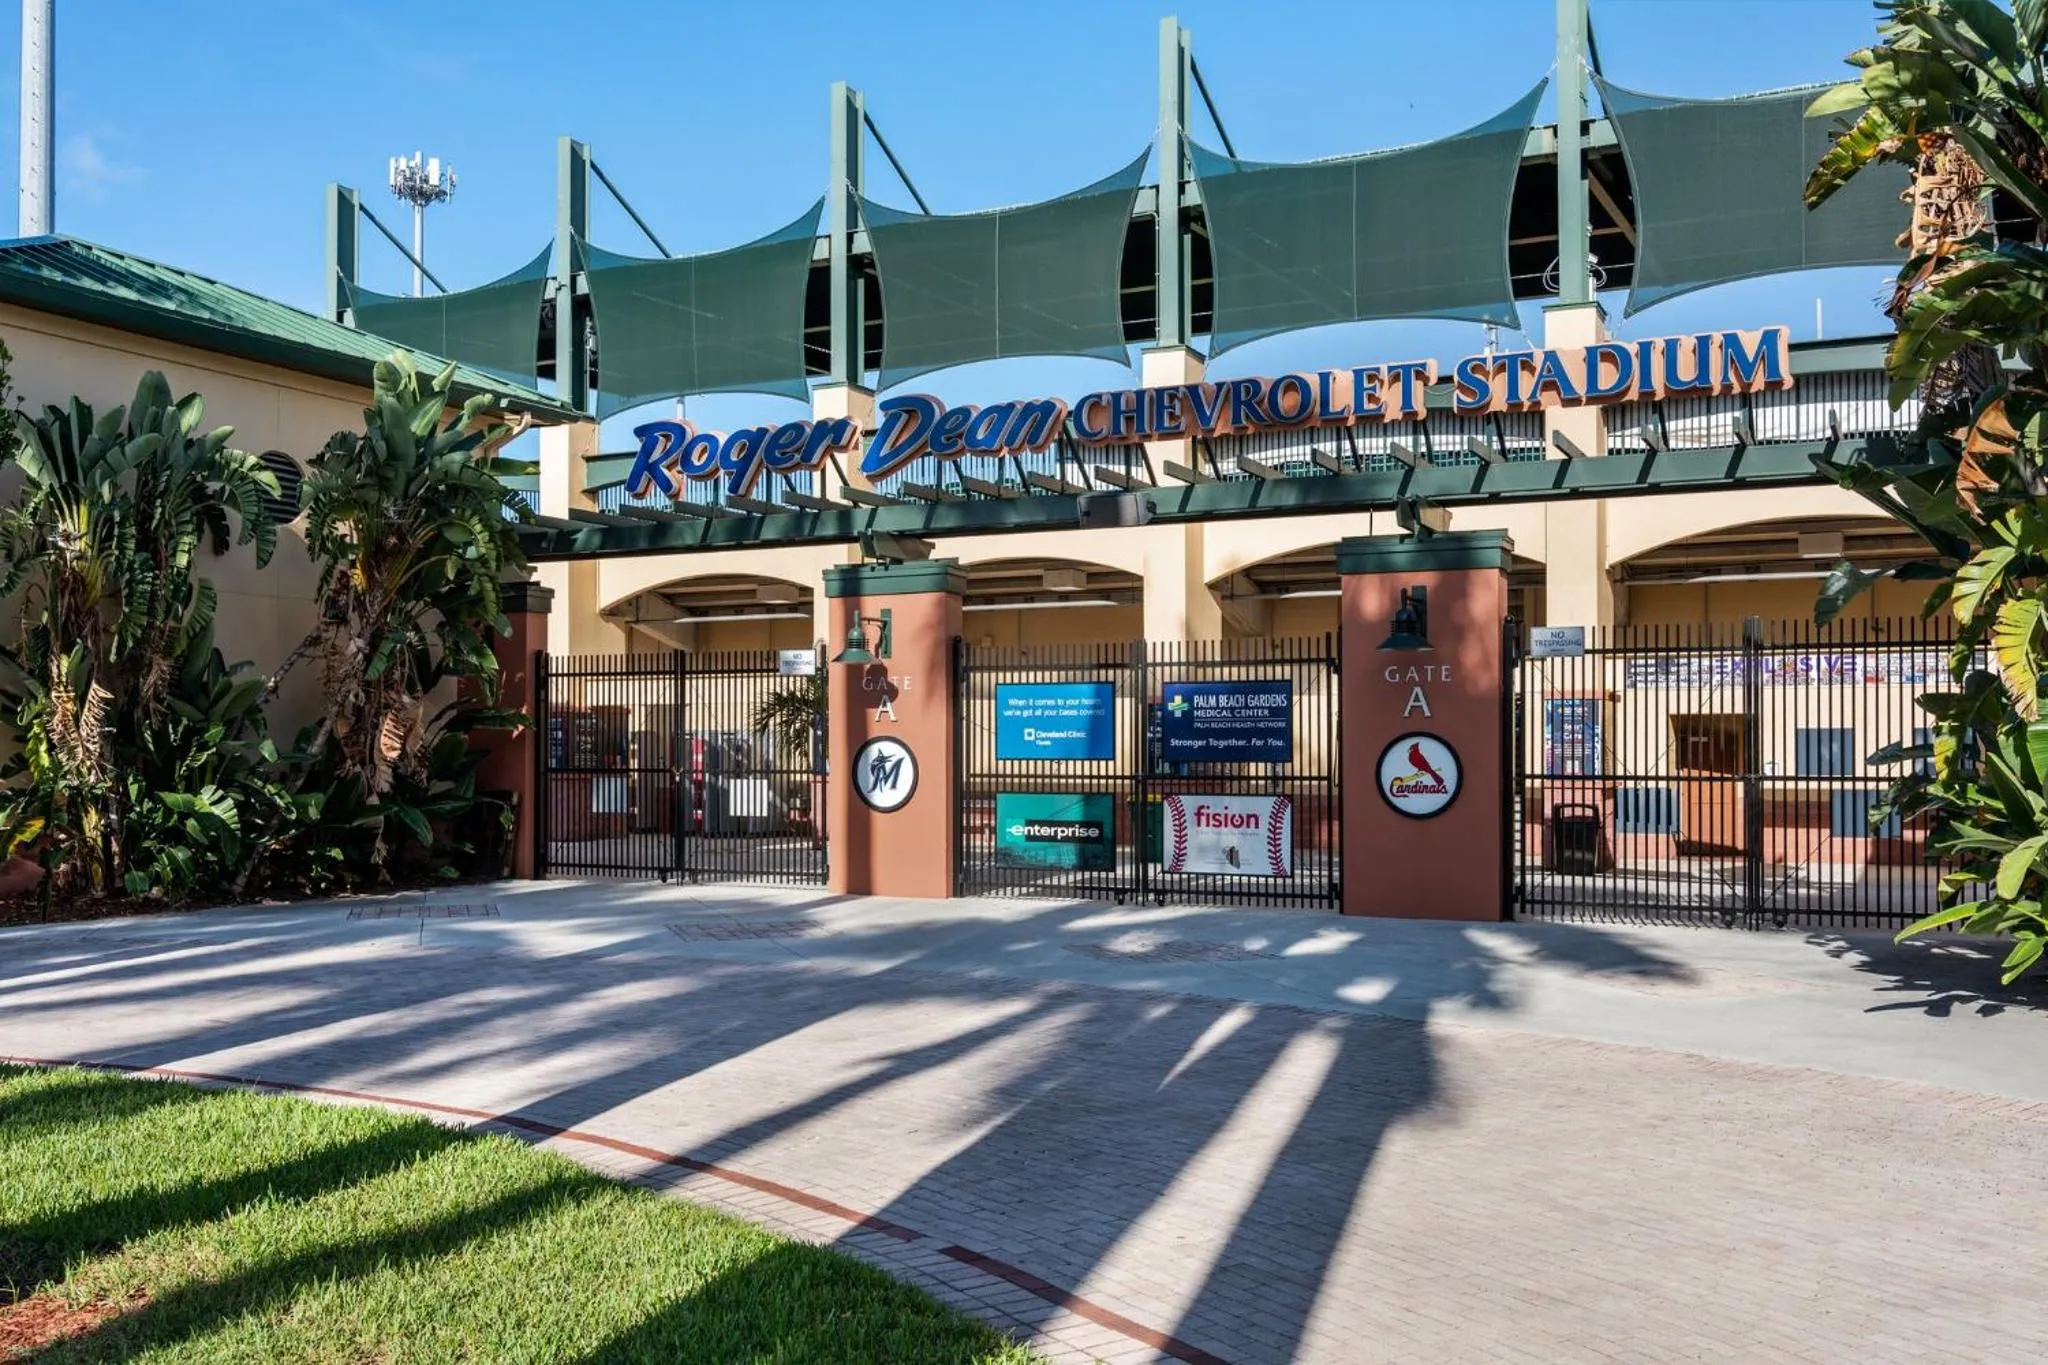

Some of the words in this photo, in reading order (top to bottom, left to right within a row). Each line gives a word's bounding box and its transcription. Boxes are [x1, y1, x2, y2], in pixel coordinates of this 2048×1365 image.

[624, 416, 856, 498] Roger
[860, 393, 1064, 480] Dean
[1075, 359, 1433, 442] CHEVROLET
[1453, 325, 1793, 416] STADIUM
[1551, 631, 1565, 639] NO
[1385, 665, 1451, 683] GATE
[862, 676, 912, 690] GATE
[1008, 698, 1026, 706] When
[1193, 694, 1216, 707] PALM
[1218, 694, 1245, 707] BEACH
[1247, 693, 1287, 707] GARDENS
[1402, 686, 1432, 717] A
[875, 694, 898, 722] A
[1022, 709, 1033, 717] got
[1034, 709, 1042, 717] all
[1193, 708, 1232, 717] MEDICAL
[1234, 708, 1269, 717] CENTER
[1169, 737, 1206, 749] Stronger
[1208, 737, 1248, 748] Together.
[1250, 737, 1264, 746] For
[1266, 738, 1286, 747] You.
[1390, 776, 1449, 798] Cardinals
[1193, 804, 1260, 829] fision
[1006, 824, 1100, 840] enterprise
